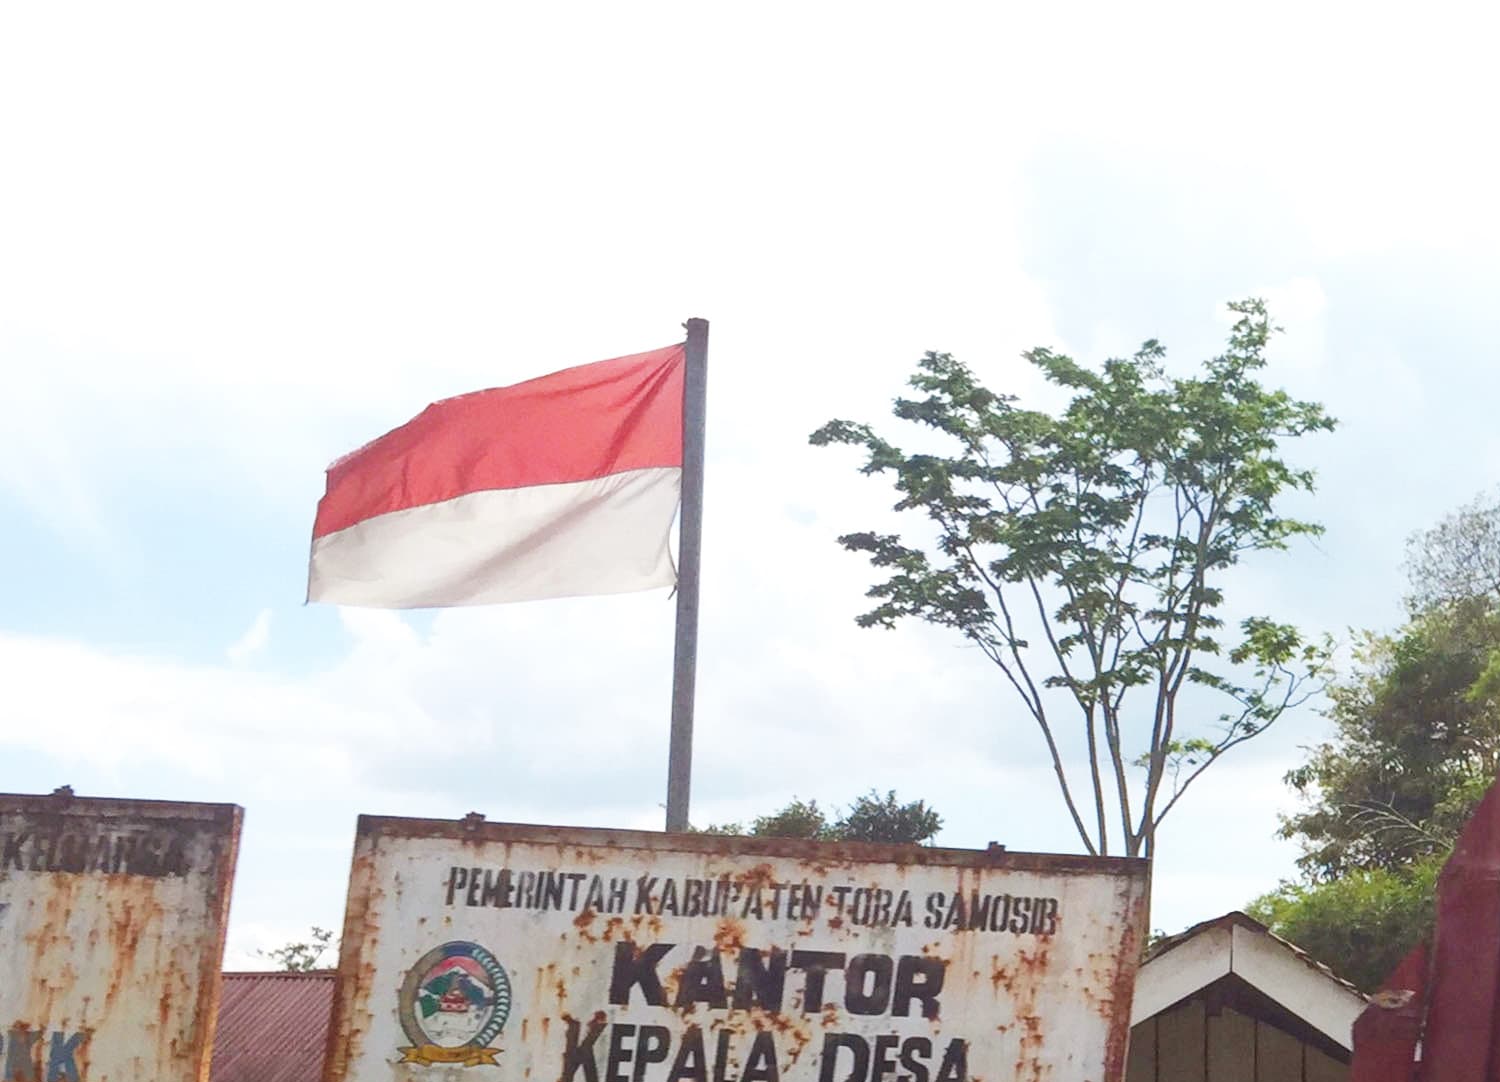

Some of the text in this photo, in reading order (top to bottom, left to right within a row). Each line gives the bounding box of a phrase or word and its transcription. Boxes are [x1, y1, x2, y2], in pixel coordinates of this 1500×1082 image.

[446, 866, 628, 914] PEMERINTAH
[634, 874, 824, 921] KABUPATEN
[831, 886, 913, 927] TOBA
[608, 940, 946, 1018] KANTOR
